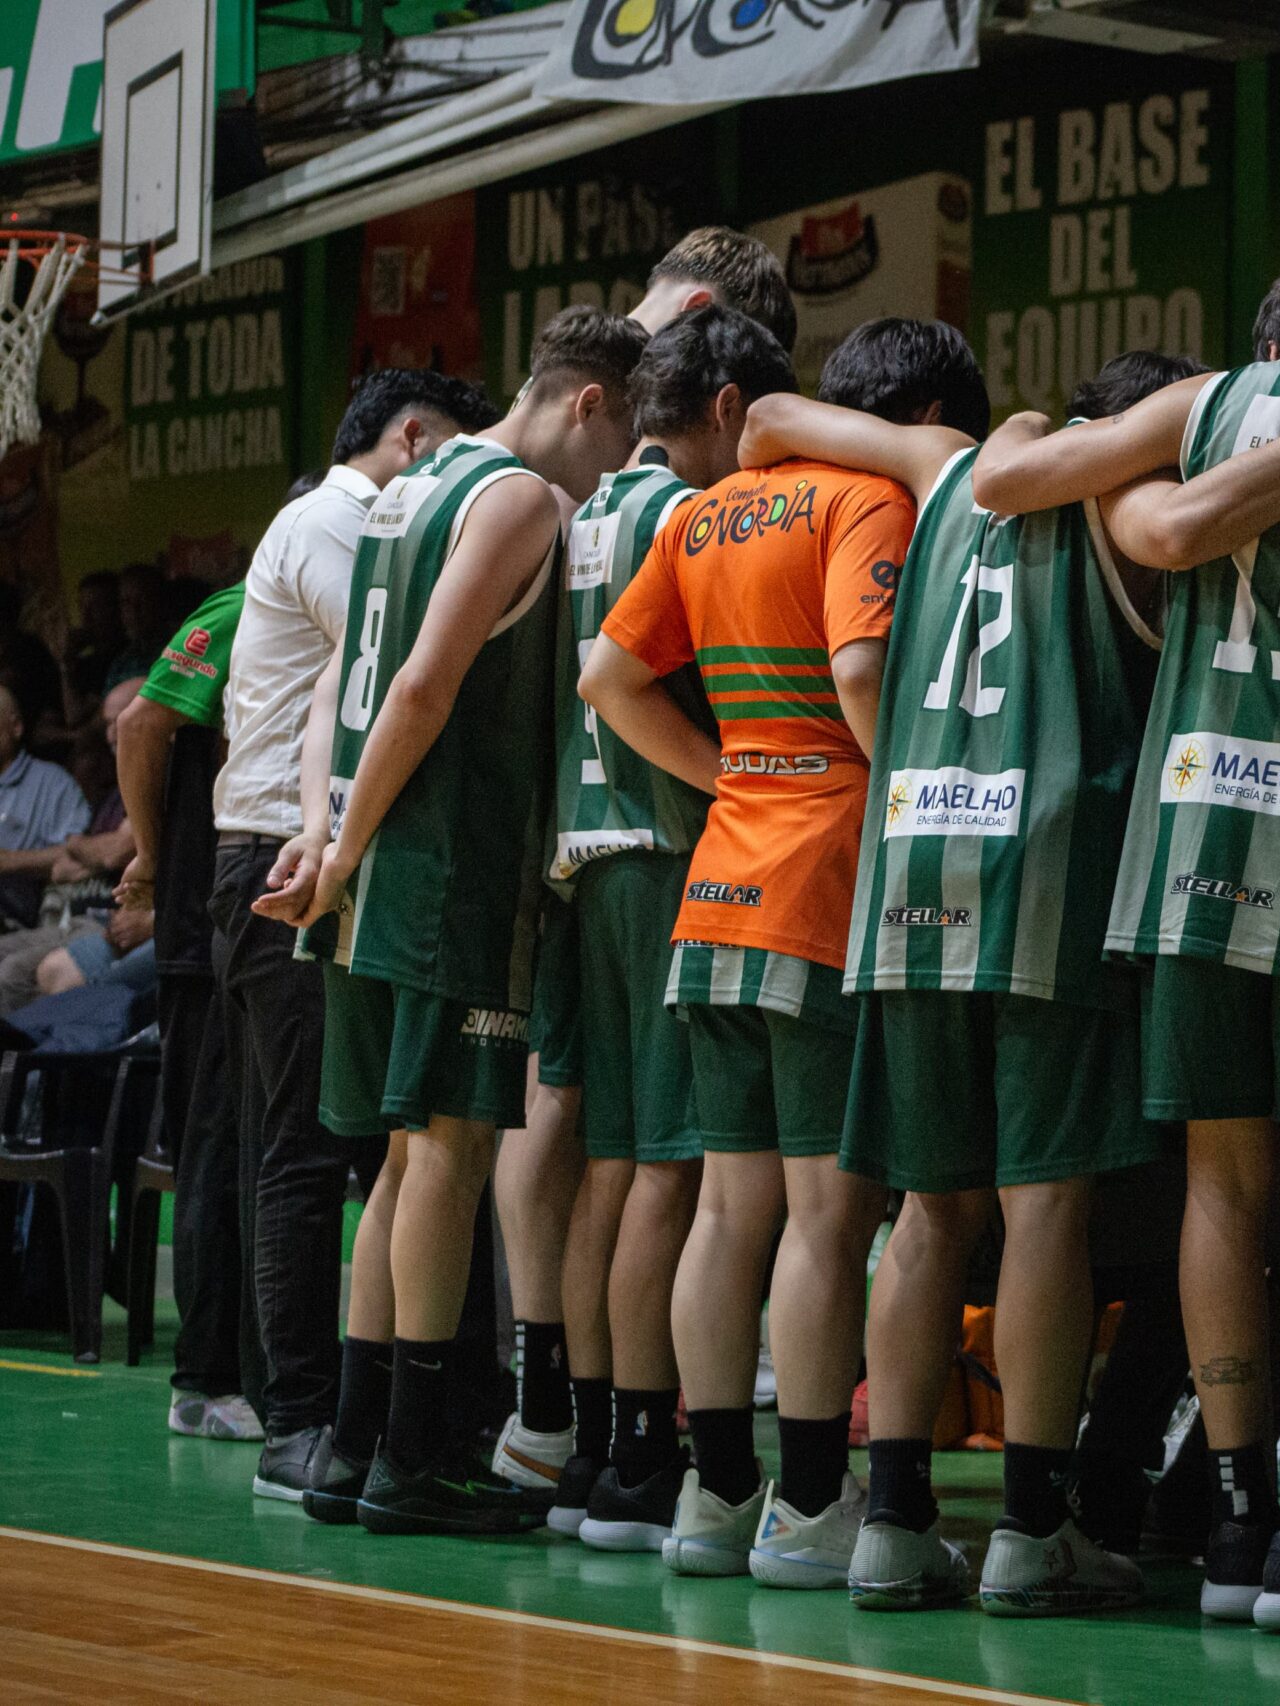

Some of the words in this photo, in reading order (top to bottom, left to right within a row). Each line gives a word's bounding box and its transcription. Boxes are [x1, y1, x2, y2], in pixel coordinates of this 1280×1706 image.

[985, 115, 1043, 216] EL
[1056, 89, 1210, 207] BASE
[508, 184, 565, 271] UN
[1051, 205, 1138, 297] DEL
[131, 325, 175, 405] DE
[184, 308, 285, 398] TODA
[130, 417, 160, 480] LA
[167, 403, 285, 475] CANCHA
[341, 588, 388, 731] 8
[923, 554, 1014, 717] 12
[916, 784, 1016, 812] MAELHO
[916, 812, 950, 826] ENERGÍA
[952, 814, 963, 825] DE
[964, 814, 1007, 827] CALIDAD
[1215, 782, 1260, 801] ENERGÍA
[1262, 791, 1278, 805] DE
[568, 844, 648, 865] MAE
